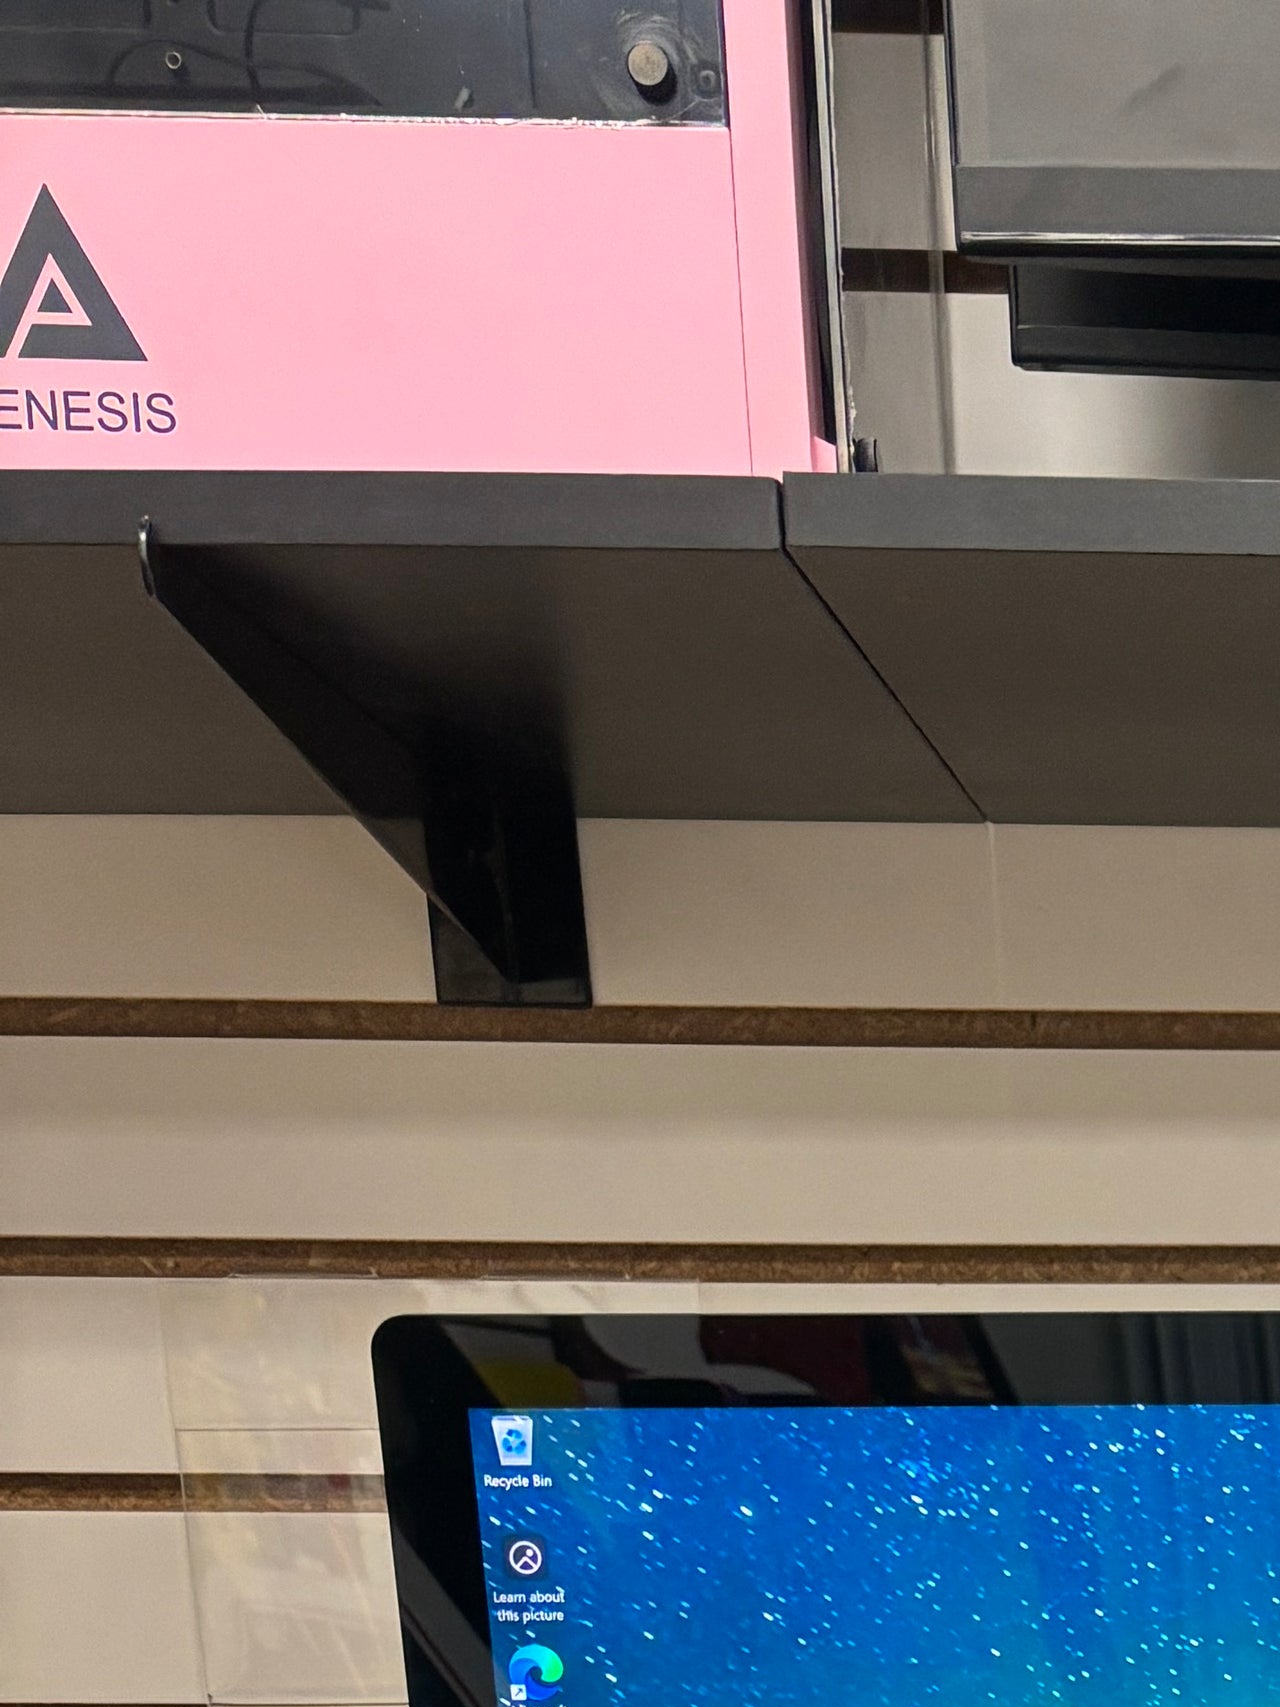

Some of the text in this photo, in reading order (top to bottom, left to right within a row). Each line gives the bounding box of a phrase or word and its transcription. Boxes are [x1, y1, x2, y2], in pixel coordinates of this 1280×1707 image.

[484, 1474, 552, 1489] Recycle Bin
[493, 1591, 565, 1604] Learn about
[497, 1609, 564, 1624] this picture
